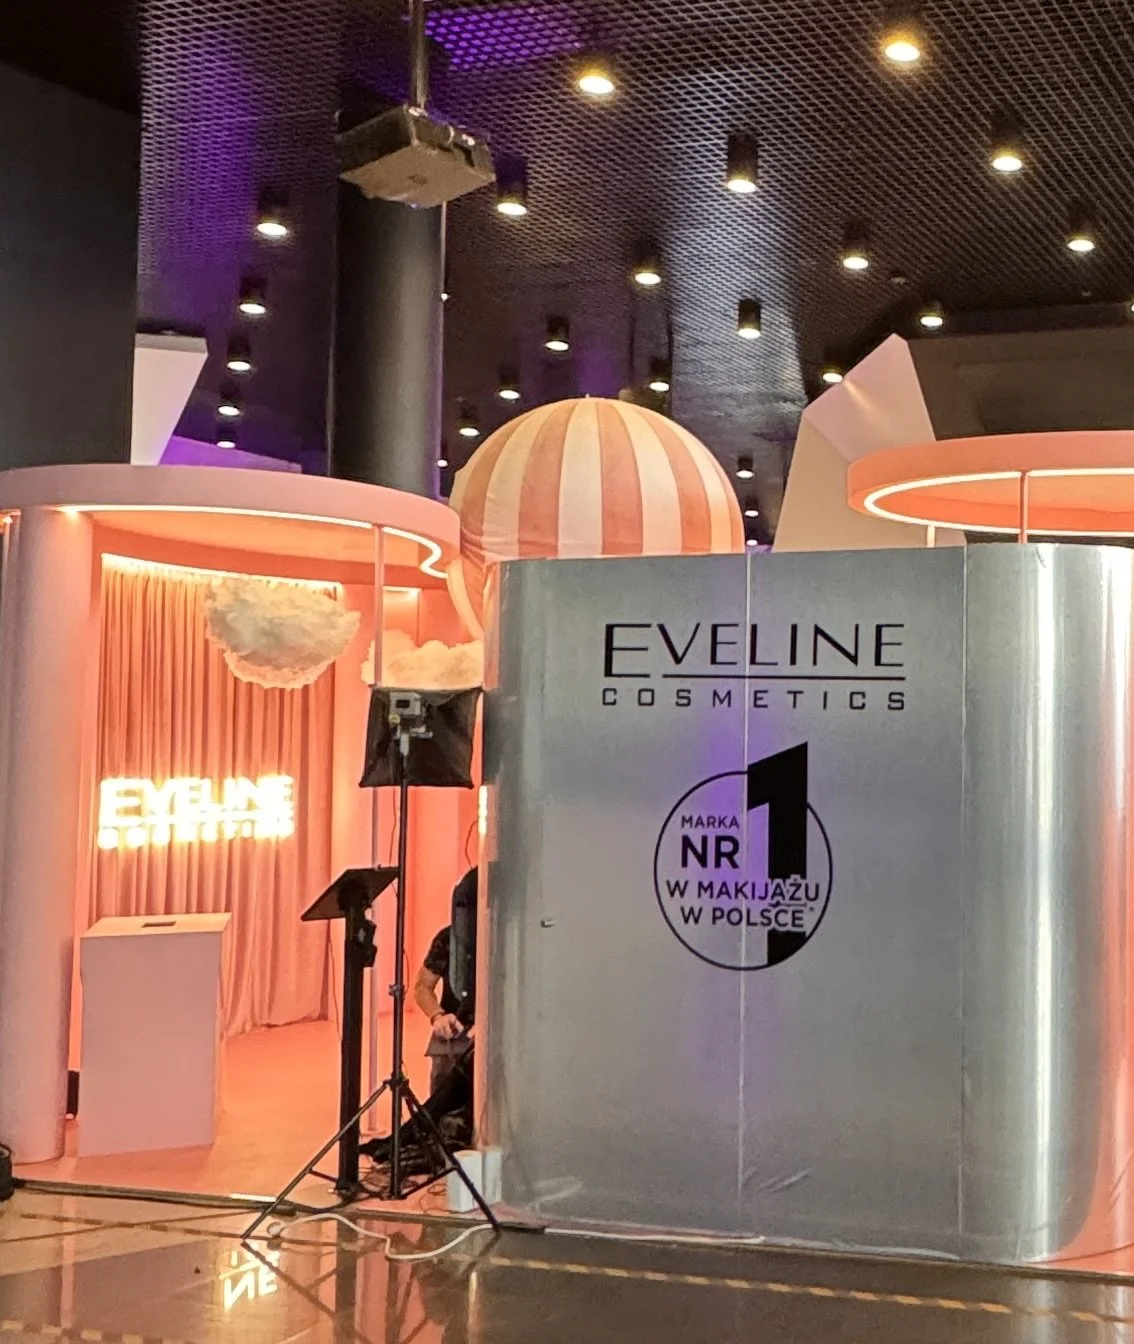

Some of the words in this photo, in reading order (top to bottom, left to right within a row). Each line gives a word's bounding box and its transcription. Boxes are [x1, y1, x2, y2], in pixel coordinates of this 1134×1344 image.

[604, 623, 905, 678] EVELINE
[602, 687, 905, 711] COSMETICS
[99, 776, 294, 827] EVELINE
[681, 815, 740, 830] MARKA
[681, 834, 740, 869] NR
[747, 741, 808, 966] 1
[666, 879, 689, 899] W
[697, 877, 820, 902] MAKIJAŻU
[680, 906, 703, 925] W
[711, 907, 804, 928] POLSCE
